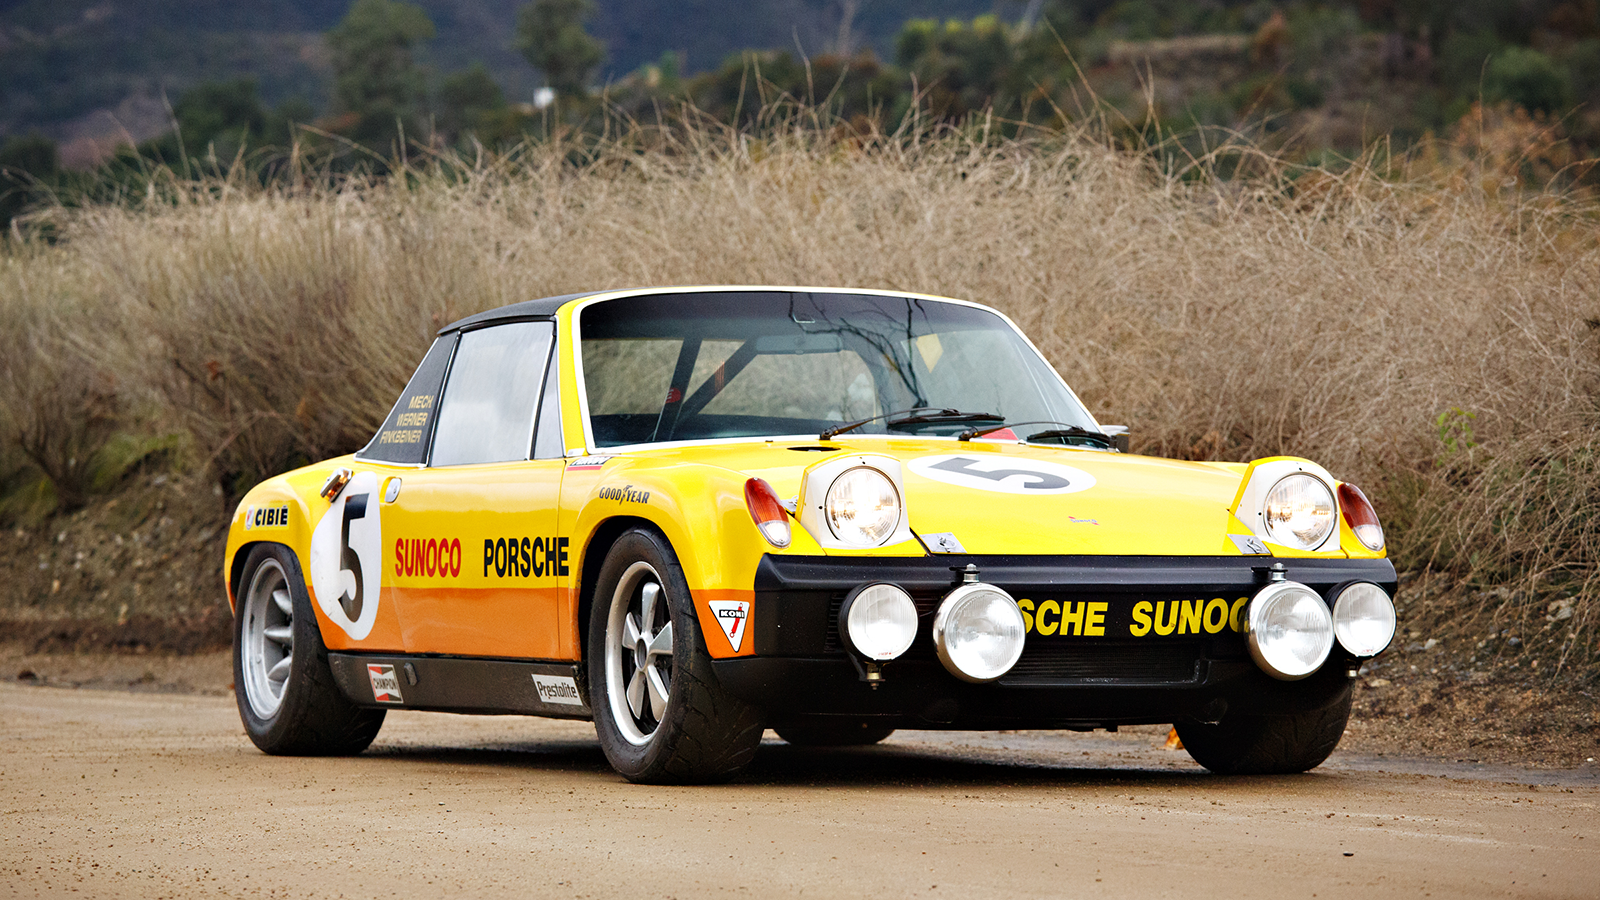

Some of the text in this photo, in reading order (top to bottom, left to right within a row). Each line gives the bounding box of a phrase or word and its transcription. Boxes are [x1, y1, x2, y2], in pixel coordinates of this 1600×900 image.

[408, 395, 434, 409] MECH
[396, 412, 429, 427] WERNER
[379, 429, 423, 444] FINKBEINER
[928, 456, 1071, 490] 5
[338, 493, 370, 623] 5
[395, 536, 570, 578] SUNOCO PORSCHE
[720, 610, 744, 618] KONI
[1017, 597, 1250, 637] SCHE SUNOC
[373, 677, 397, 690] CHAMPION
[536, 681, 578, 700] Prestolite
